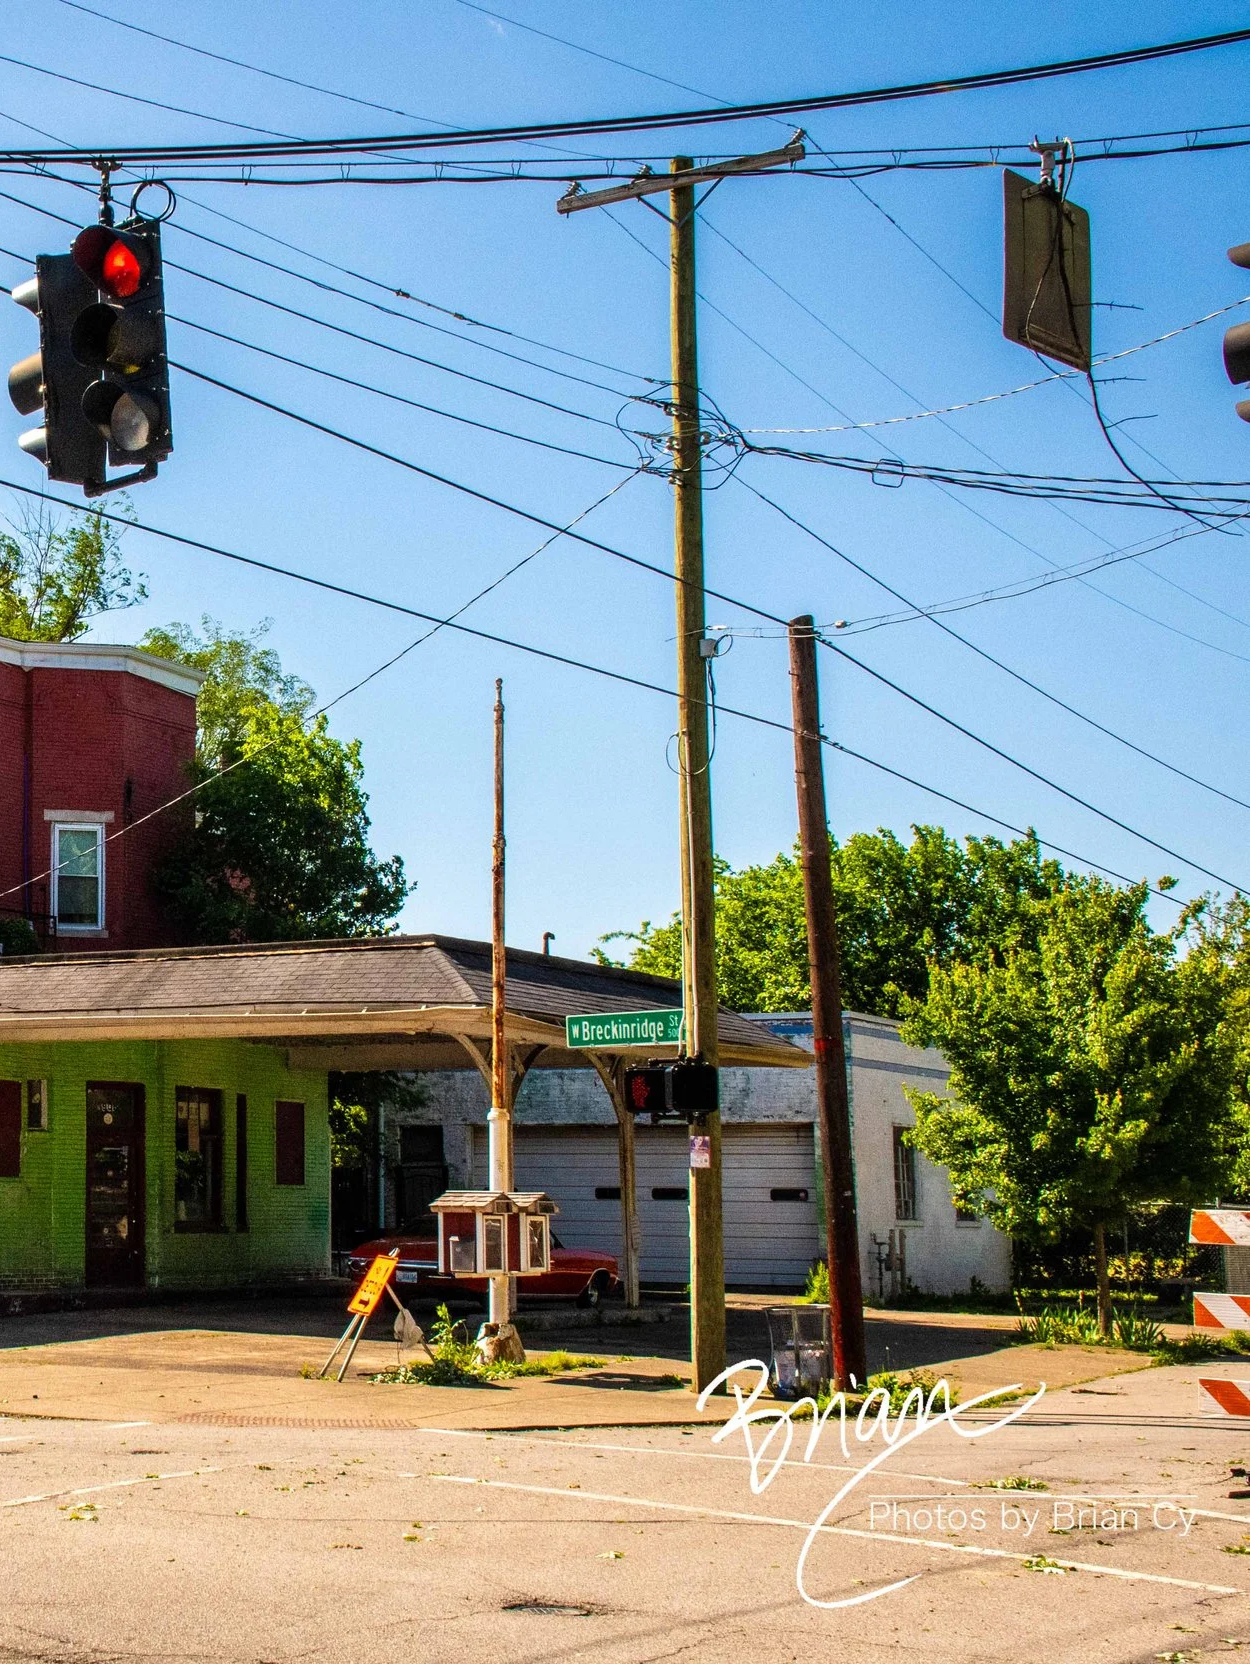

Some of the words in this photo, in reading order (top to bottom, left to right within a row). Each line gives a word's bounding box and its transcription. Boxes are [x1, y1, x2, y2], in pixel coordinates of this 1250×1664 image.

[571, 1024, 579, 1039] W
[582, 1019, 664, 1043] Breckinridge
[669, 1014, 678, 1027] St
